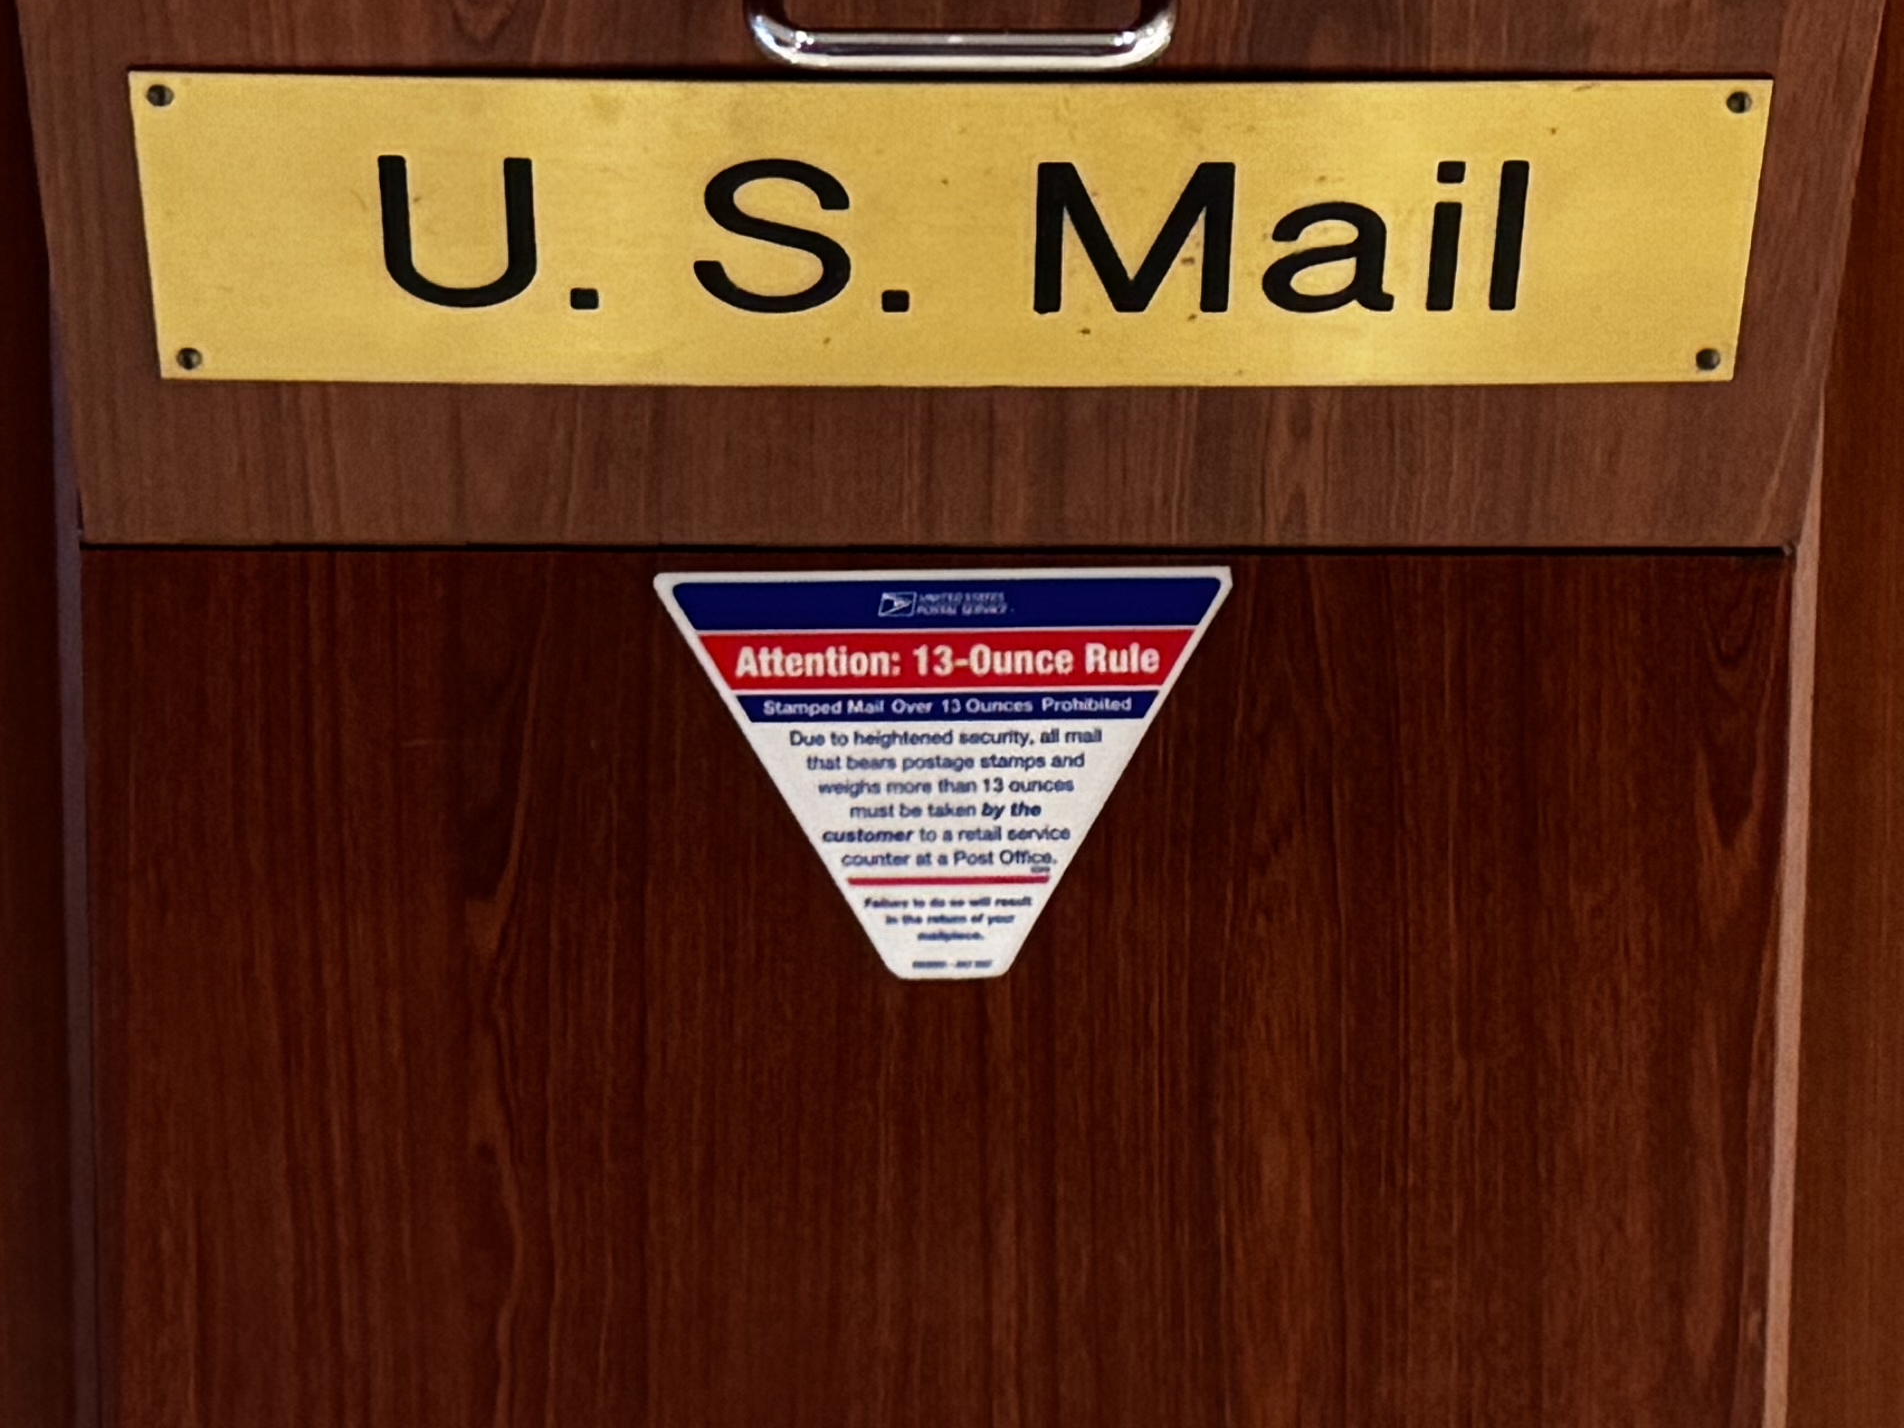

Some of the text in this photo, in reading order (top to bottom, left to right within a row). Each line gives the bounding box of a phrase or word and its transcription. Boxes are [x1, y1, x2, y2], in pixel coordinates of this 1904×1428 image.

[374, 153, 1532, 315] U. S. Mail
[734, 642, 1161, 678] Attention: 13-Ounce Rule
[762, 696, 1133, 718] Stamped Mail Over 13 Ounces Prohibited
[789, 727, 1103, 750] Due to heightened security, all mail
[806, 752, 1086, 773] that bears postage stamps and
[817, 777, 1075, 798] weighs more than 13 ounces
[849, 800, 1042, 820] must be taken by the
[821, 825, 1071, 843] customer to a retail service
[840, 849, 1058, 867] counter at a Post Office.
